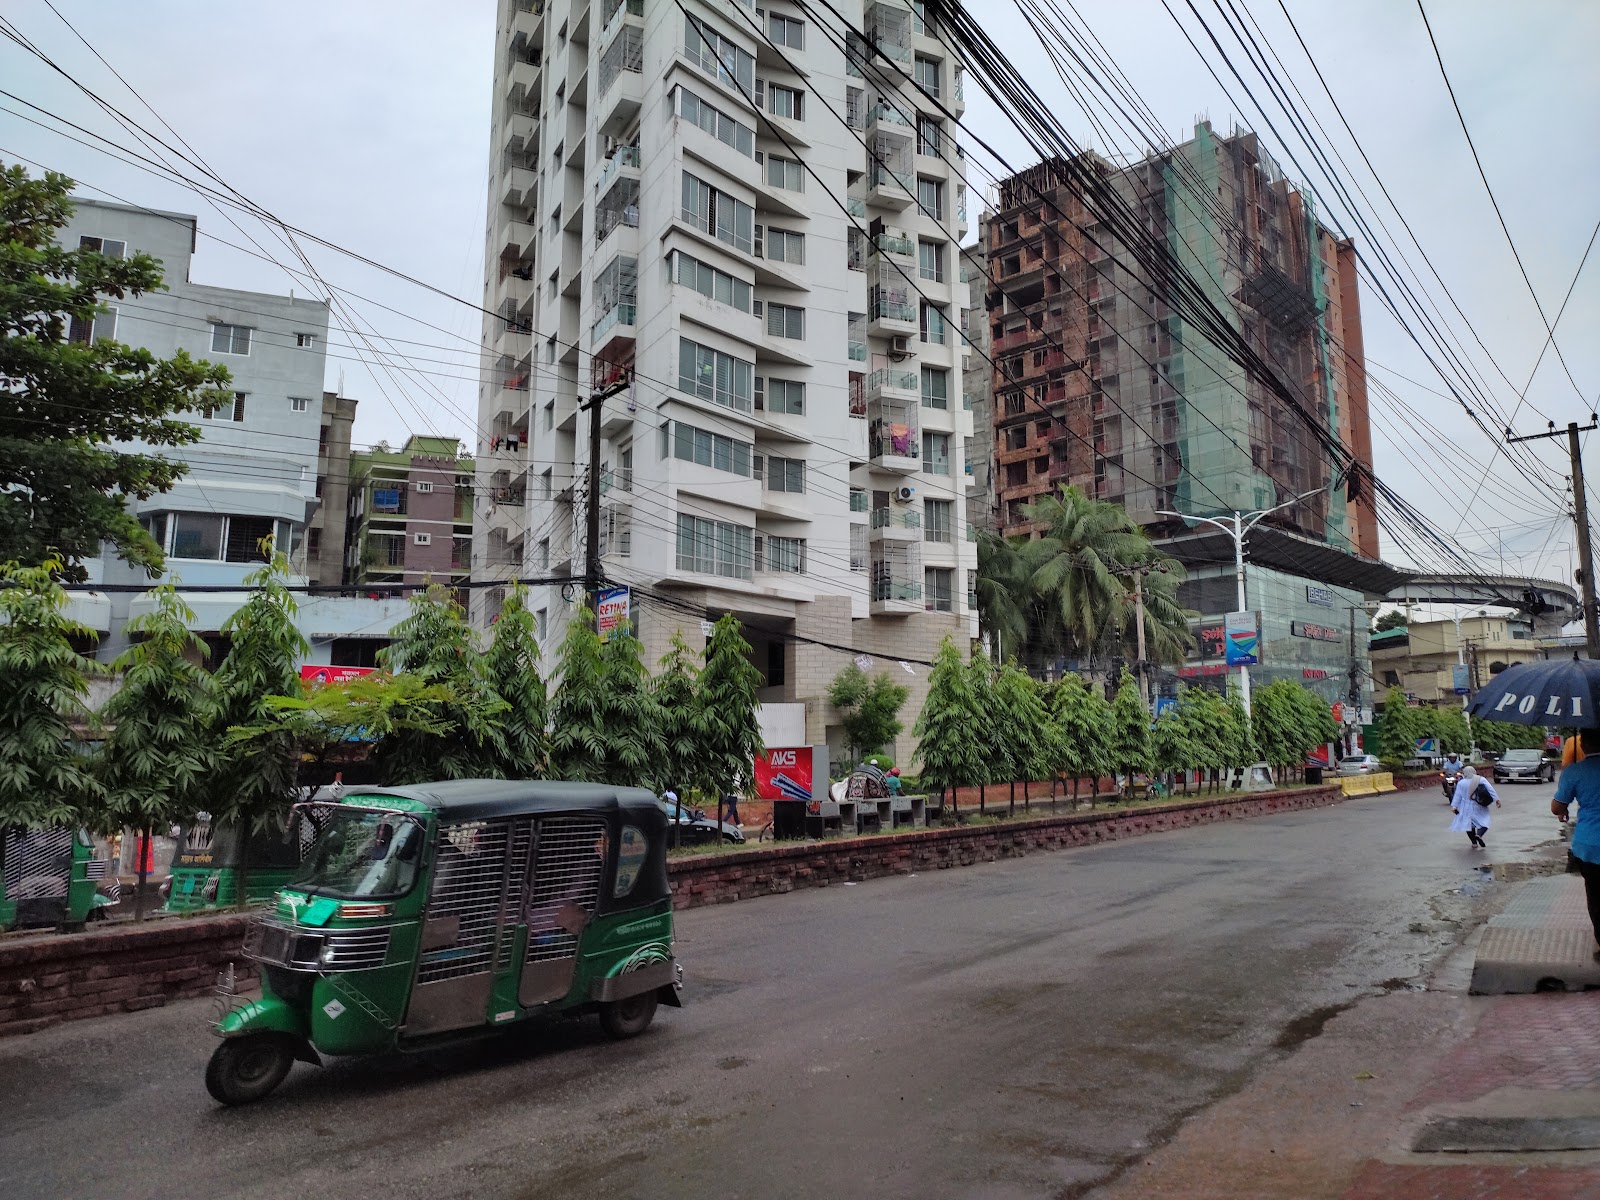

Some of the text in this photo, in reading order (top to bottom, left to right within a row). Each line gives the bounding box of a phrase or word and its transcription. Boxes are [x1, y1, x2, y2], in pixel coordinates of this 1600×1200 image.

[600, 601, 627, 615] RETINA
[1494, 692, 1600, 717] POLI
[771, 750, 797, 766] AKS
